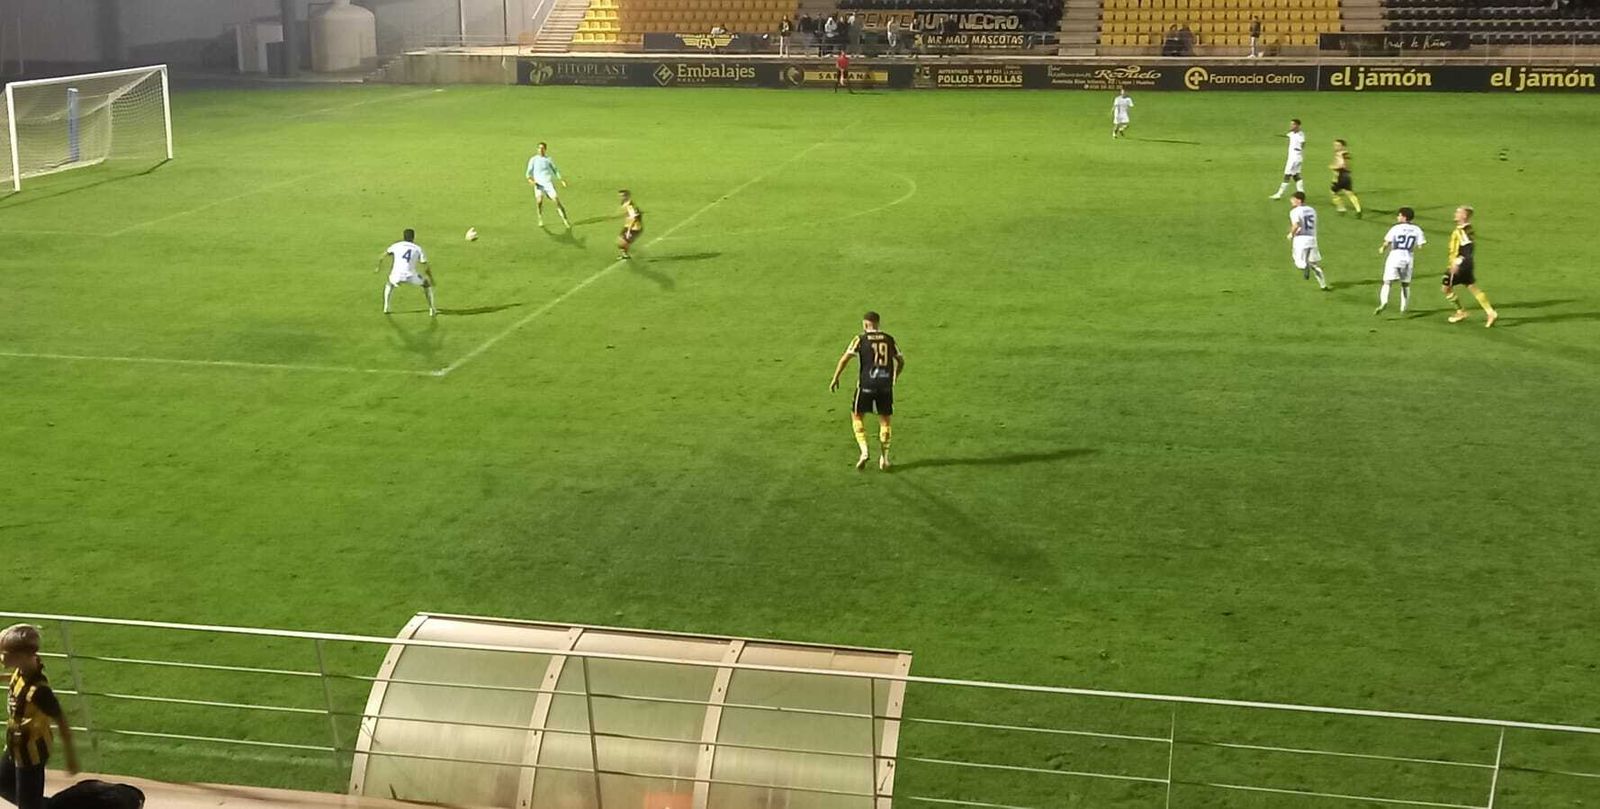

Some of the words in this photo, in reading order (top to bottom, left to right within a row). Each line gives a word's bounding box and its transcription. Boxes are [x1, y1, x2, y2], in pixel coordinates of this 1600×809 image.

[946, 35, 968, 44] MAD
[971, 35, 1024, 44] MASCOTAS
[556, 63, 628, 75] FITOPLAST
[677, 63, 756, 80] Embalajes
[937, 75, 975, 84] POLLOS
[977, 75, 984, 84] Y
[985, 75, 1023, 84] POLLAS
[1210, 74, 1264, 84] Farmacia
[1265, 73, 1305, 84] Centro
[1330, 67, 1352, 86] el
[1355, 67, 1432, 90] jamón
[1490, 67, 1512, 86] el
[1515, 67, 1596, 91] jamón
[1304, 214, 1314, 230] 15
[1397, 234, 1416, 250] 20
[402, 249, 412, 263] 4
[871, 342, 888, 366] 19
